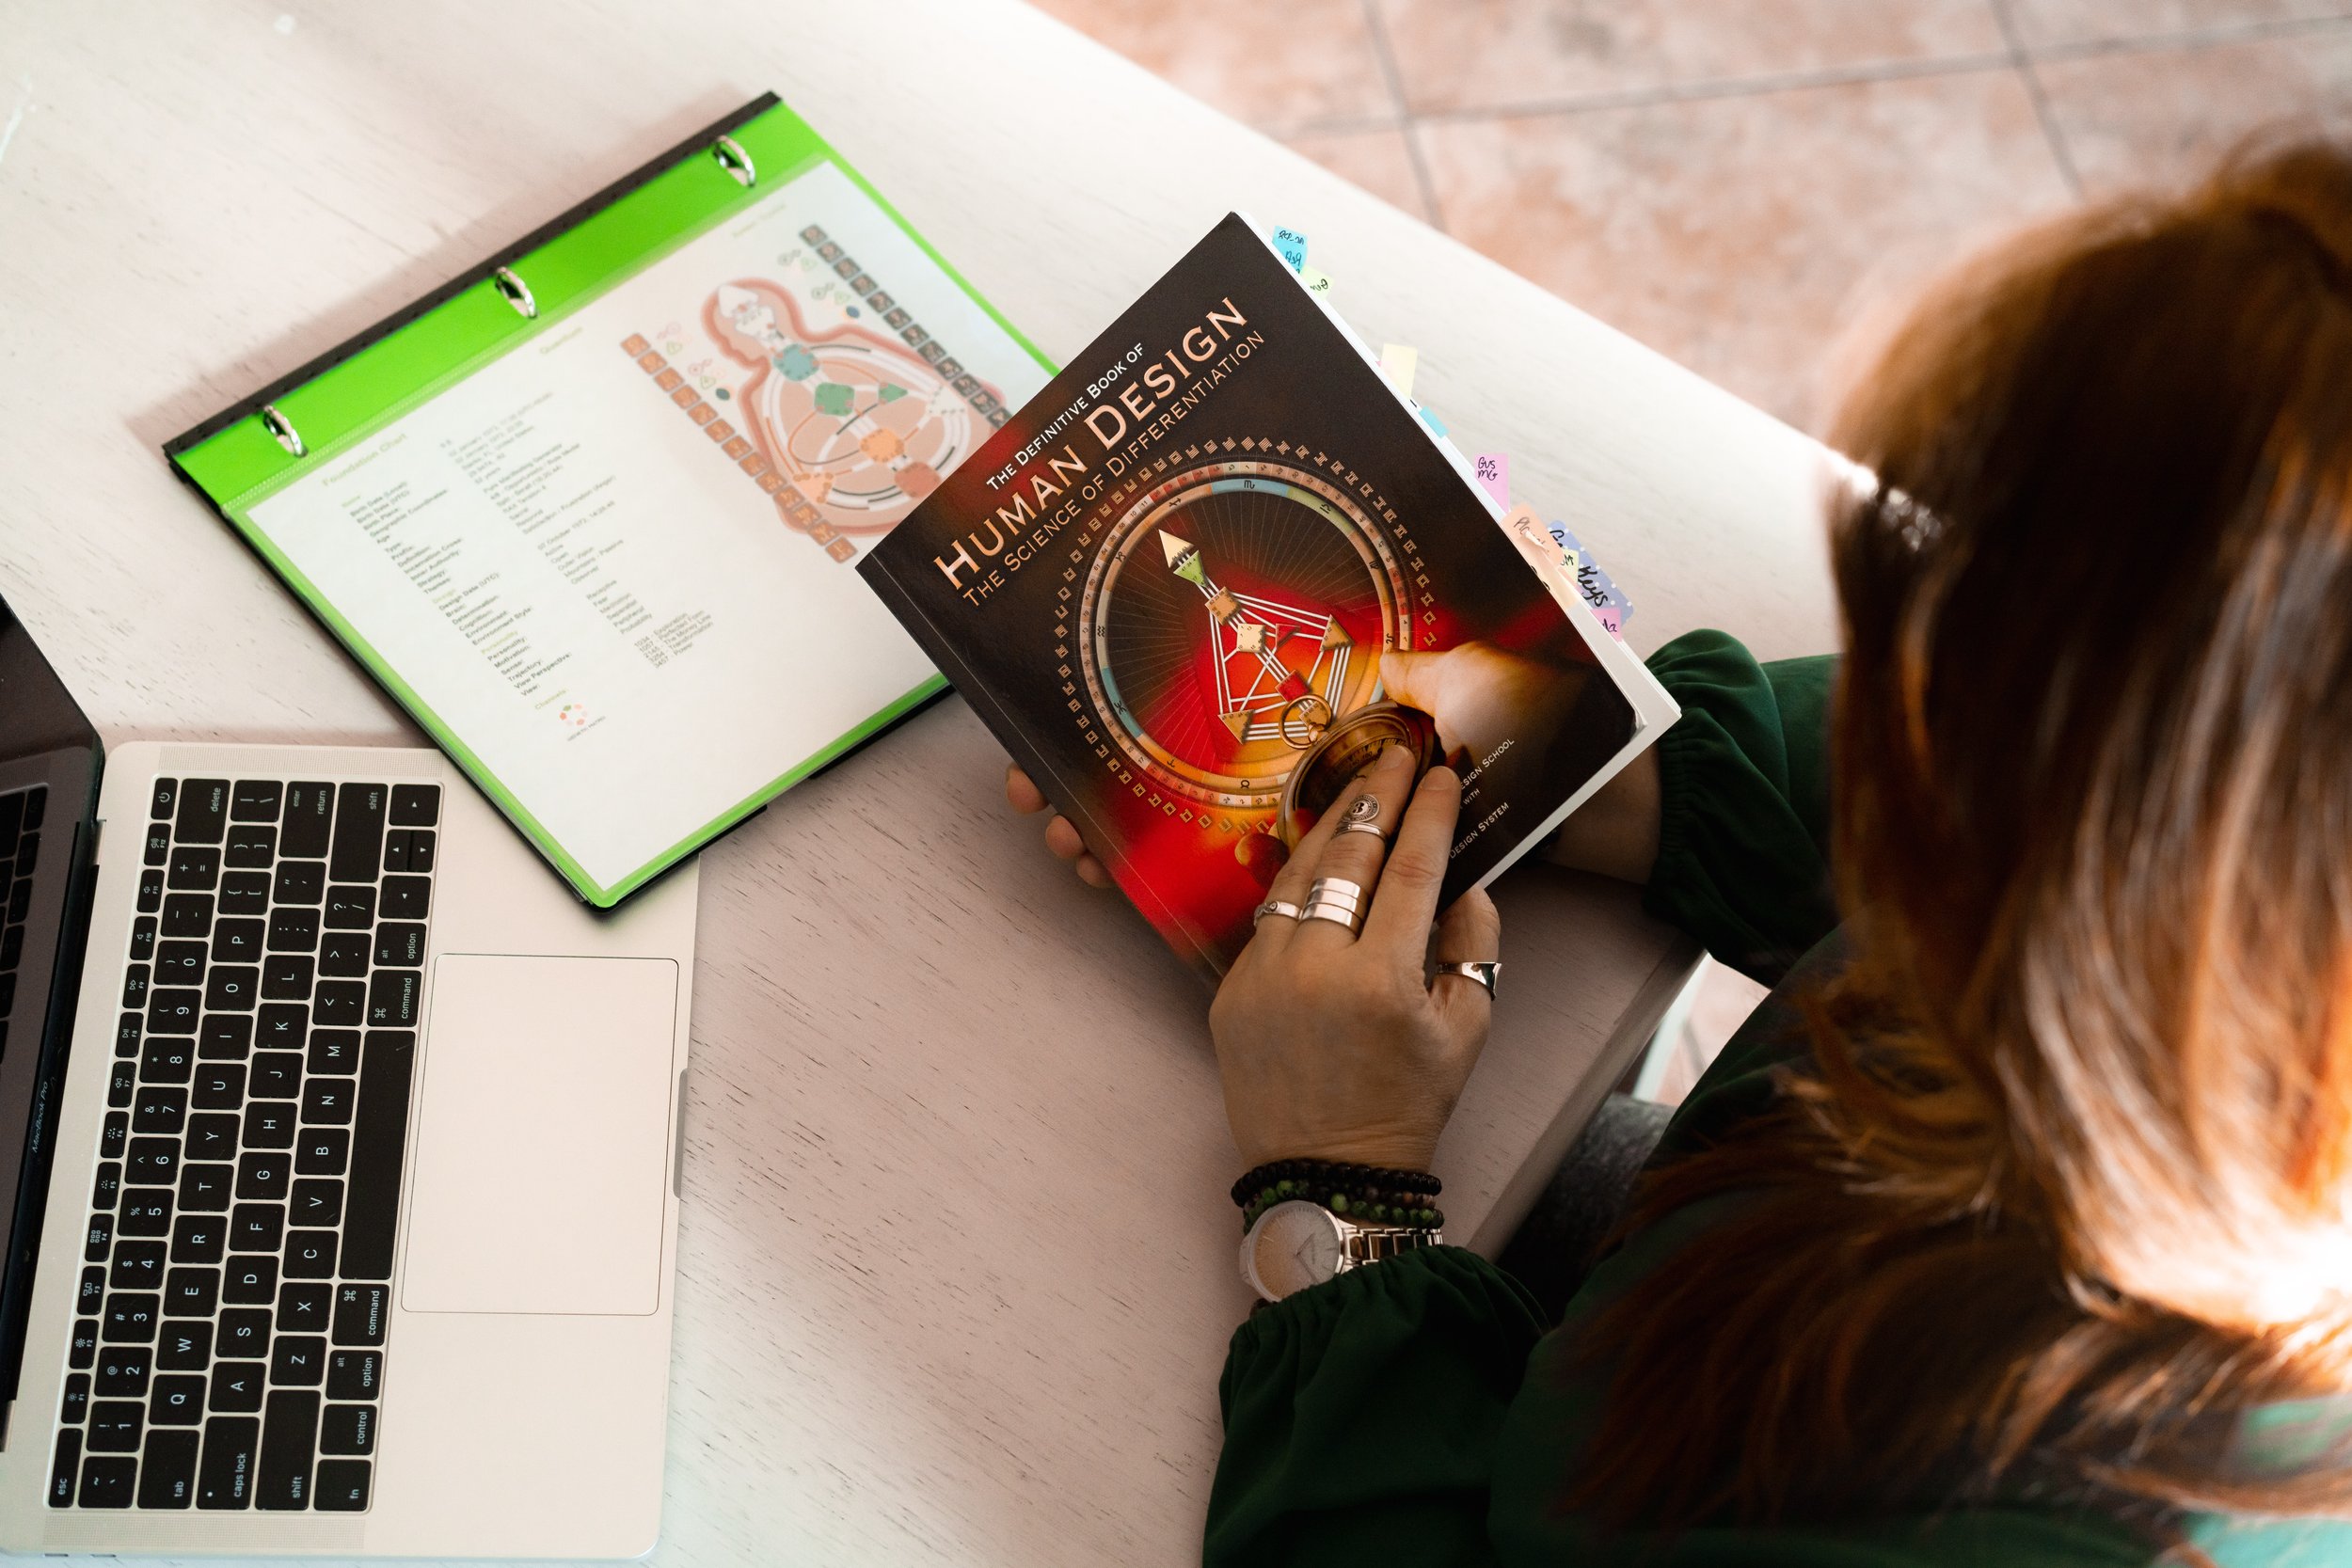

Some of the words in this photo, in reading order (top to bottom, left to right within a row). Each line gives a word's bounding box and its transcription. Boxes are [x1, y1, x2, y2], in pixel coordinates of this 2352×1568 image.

[986, 464, 1017, 490] THE
[1014, 396, 1089, 467] DEFINITIVE
[1086, 361, 1127, 399] BOOK
[1125, 342, 1144, 363] OF
[933, 444, 1089, 590] HUMAN
[1084, 296, 1248, 451] DESIGN
[962, 569, 1006, 610] THE
[1004, 499, 1082, 572] SCIENCE
[1082, 473, 1107, 500] OF
[1105, 330, 1265, 477] DIFFERENTIATION
[1460, 766, 1483, 790] ESIGN
[1481, 737, 1515, 768] SCHOOL
[210, 787, 221, 813] delete
[293, 789, 301, 807] enter
[368, 792, 378, 810] shift
[1463, 787, 1481, 805] WITH
[317, 790, 326, 815] return
[1477, 801, 1510, 832] SYSTEM
[231, 935, 245, 944] P
[406, 932, 417, 959] option
[280, 973, 294, 981] L
[401, 977, 412, 1020] command
[176, 1006, 190, 1015] 9
[275, 1022, 289, 1031] K
[326, 1045, 342, 1057] M
[169, 1055, 183, 1065] 8
[269, 1070, 283, 1079] J
[212, 1081, 227, 1091] U
[321, 1095, 335, 1105] N
[162, 1105, 176, 1114] 7
[32, 1102, 45, 1153] MacBook
[262, 1119, 277, 1130] H
[205, 1132, 219, 1141] Y
[315, 1146, 329, 1156] B
[155, 1156, 169, 1165] 6
[256, 1170, 271, 1180] G
[198, 1181, 213, 1192] T
[309, 1196, 324, 1208] V
[148, 1207, 163, 1216] 5
[249, 1222, 263, 1231] F
[191, 1234, 206, 1244] R
[303, 1248, 318, 1259] C
[140, 1259, 155, 1269] 4
[243, 1274, 258, 1284] D
[184, 1287, 199, 1296] E
[296, 1301, 312, 1312] X
[133, 1312, 148, 1322] 3
[368, 1290, 380, 1336] command
[236, 1326, 251, 1338] S
[177, 1338, 192, 1353] W
[291, 1354, 306, 1365] Z
[337, 1357, 345, 1368] alt
[125, 1366, 140, 1375] 2
[362, 1356, 373, 1387] option
[230, 1381, 245, 1392] A
[170, 1393, 186, 1405] Q
[357, 1411, 368, 1445] control
[233, 1452, 246, 1472] lock
[57, 1478, 68, 1496] esc
[173, 1481, 184, 1497] tab
[233, 1473, 246, 1497] caps
[291, 1476, 303, 1498] shift
[349, 1488, 359, 1499] fn
